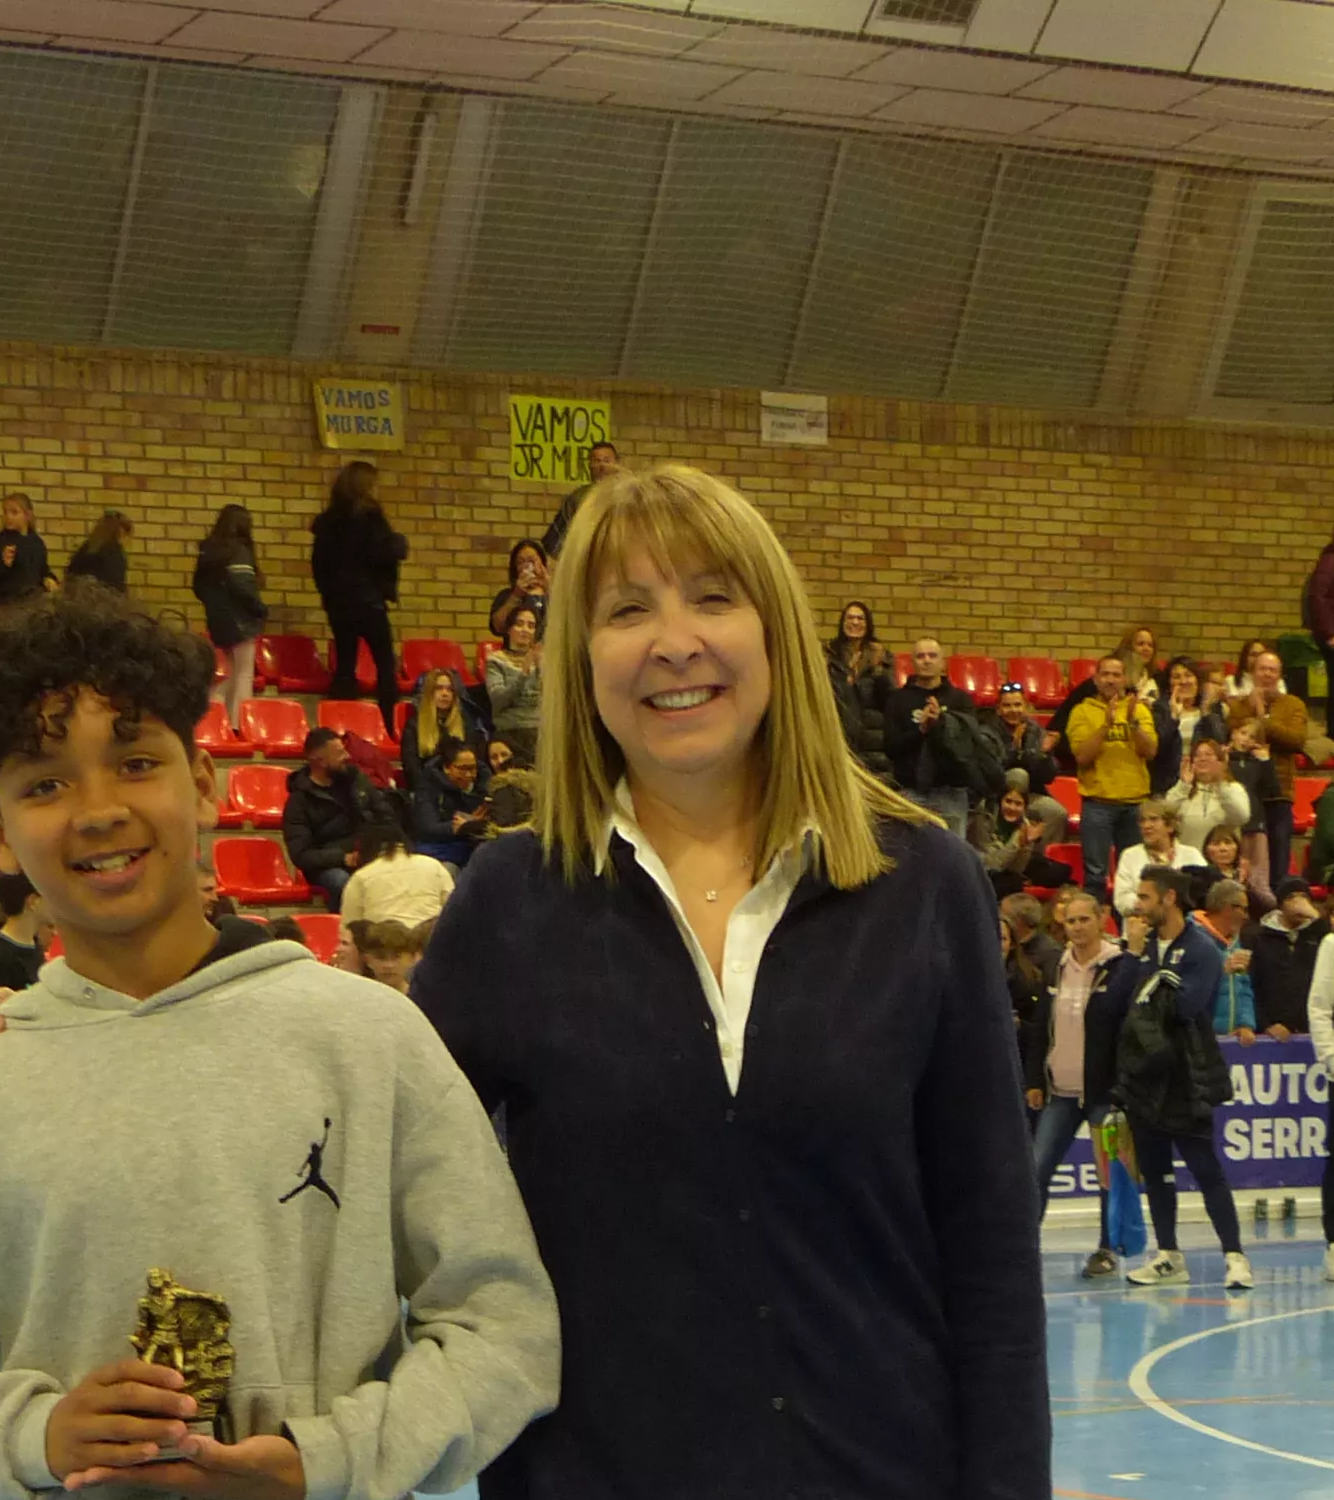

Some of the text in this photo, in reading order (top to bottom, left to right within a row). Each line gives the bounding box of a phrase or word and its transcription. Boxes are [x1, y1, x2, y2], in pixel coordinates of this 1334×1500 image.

[322, 386, 392, 410] VAMOS
[325, 413, 395, 437] MURGA
[511, 402, 607, 445] VAMOS
[1222, 1063, 1330, 1106] AUTO
